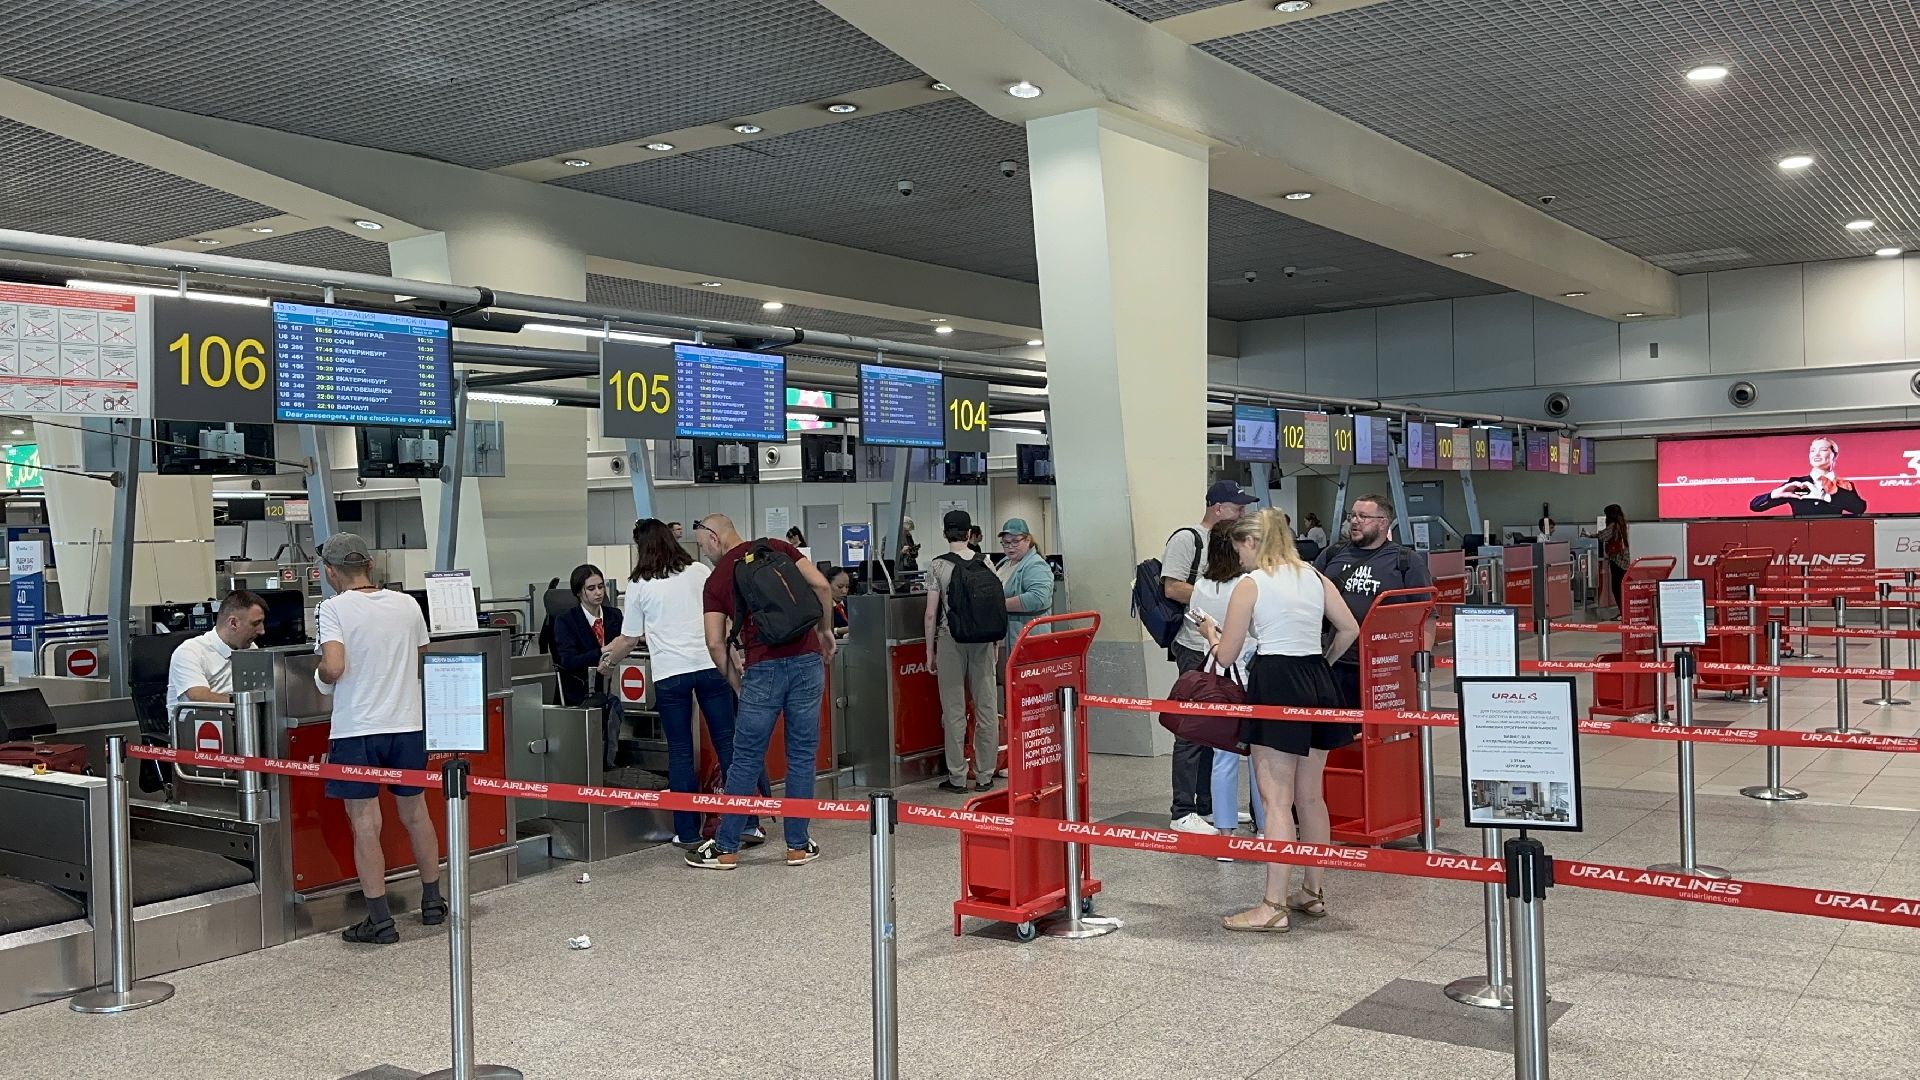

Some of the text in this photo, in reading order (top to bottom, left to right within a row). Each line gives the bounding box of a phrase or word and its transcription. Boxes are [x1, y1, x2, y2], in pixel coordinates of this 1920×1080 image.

[334, 329, 384, 340] КАЛИНИНГРАД
[169, 332, 266, 391] 106
[336, 366, 367, 374] ИРКУТСК
[336, 376, 388, 384] ЕКАТЕРИНБУРГ
[609, 370, 671, 414] 105
[950, 398, 987, 432] 104
[1284, 425, 1304, 449] 102
[1334, 429, 1352, 451] 101
[1439, 439, 1452, 458] 100
[1476, 440, 1486, 458] 99
[266, 506, 284, 516] 120
[16, 590, 27, 604] 40
[1020, 662, 1073, 678] URAL AIRLINES
[1566, 662, 1612, 670] AIRLINES
[1703, 662, 1781, 672] URAL AIRLINES
[1812, 666, 1895, 676] URAL AIRLINES
[1084, 695, 1152, 706] URAL AIRLINES
[1492, 692, 1526, 701] URAL
[1180, 702, 1254, 713] URAL AIRLINES
[1282, 706, 1364, 718] URAL AIRLINES
[1397, 711, 1428, 720] URAL
[1651, 726, 1759, 739] URAL AIRLINES
[1801, 733, 1919, 746] URAL AIRLINES
[130, 745, 177, 758] URAL AIRLINES
[194, 752, 245, 765] URAL AIRLINES
[264, 759, 320, 772] URAL AIRLINES
[342, 766, 402, 778] URAL AIRLINES
[426, 772, 442, 782] URA
[473, 778, 549, 793] URAL AIRLINES
[578, 788, 661, 802] URAL AIRLINES
[692, 796, 782, 809] URAL AIRLINES
[818, 802, 854, 812] URAL
[908, 806, 1014, 826] URAL AIRLINES
[1058, 822, 1179, 843] URAL AIRLINES
[1228, 839, 1369, 860] URAL AIRLINES
[1316, 860, 1367, 868] uralairlines.com
[1426, 856, 1484, 871] URAL
[1570, 864, 1743, 895] URAL AIRLINES
[1679, 891, 1740, 904] uralairlines.com
[1814, 893, 1886, 913] URAL
